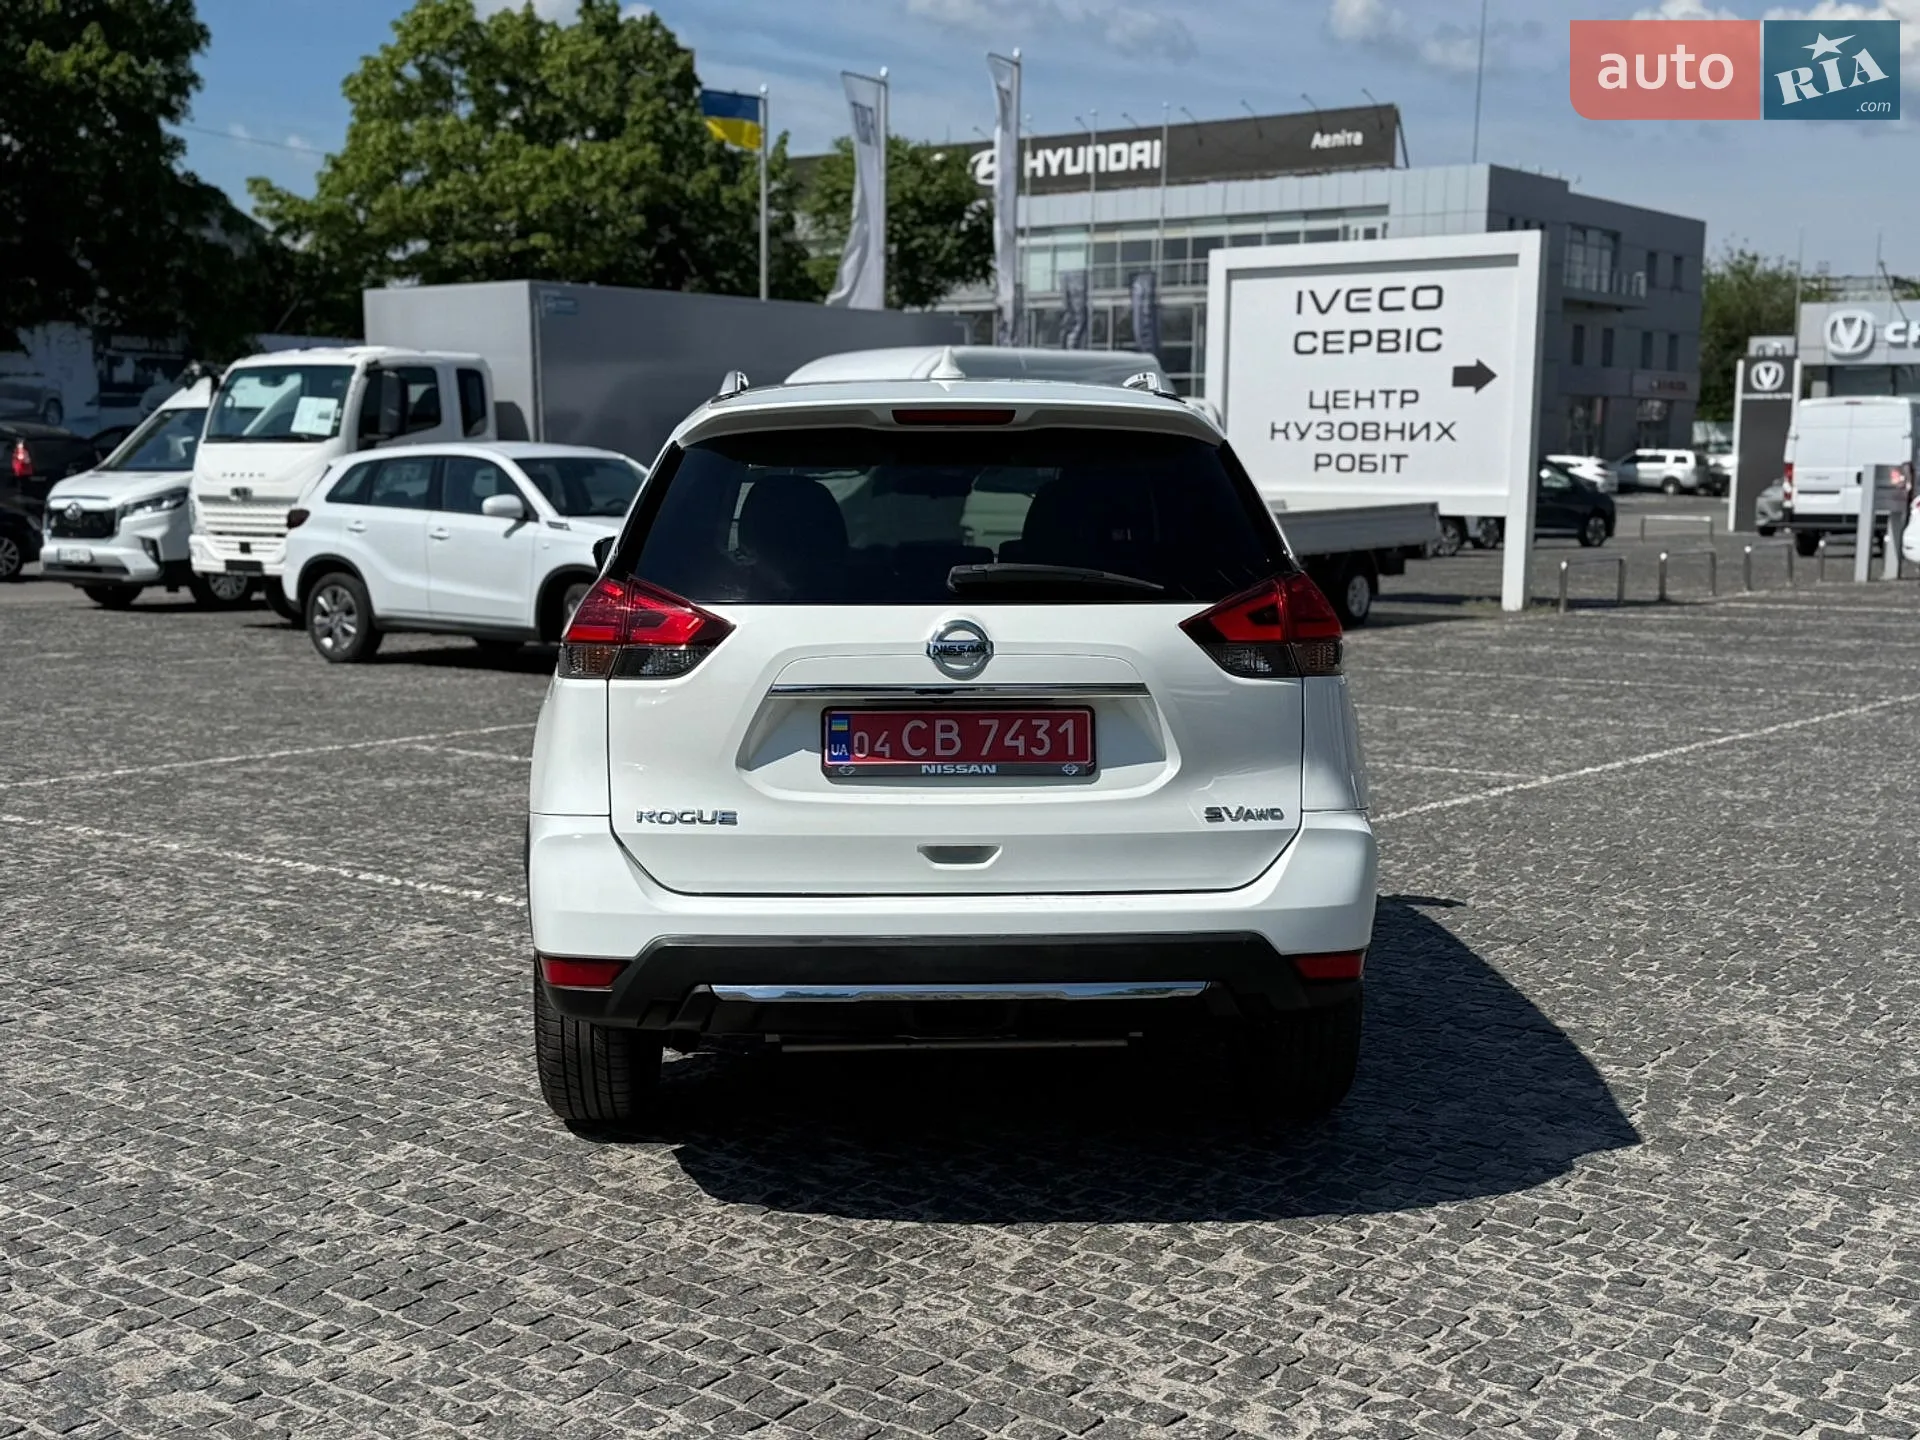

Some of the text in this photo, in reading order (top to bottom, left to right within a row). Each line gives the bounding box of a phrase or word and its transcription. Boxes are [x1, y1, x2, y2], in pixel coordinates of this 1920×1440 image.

[1023, 139, 1162, 178] HYUNDAI
[1296, 284, 1444, 315] IVECO
[1293, 327, 1443, 355] СЕРВІС
[1309, 389, 1420, 414] ЦЕНТР
[1270, 421, 1457, 442] КУЗОВНИХ
[1314, 452, 1409, 473] РОБІТ
[932, 644, 988, 654] NISSAN
[853, 718, 1076, 759] 04 CB 7431
[831, 744, 848, 757] UA
[921, 764, 997, 774] NISSAN
[636, 809, 738, 826] ROGUE
